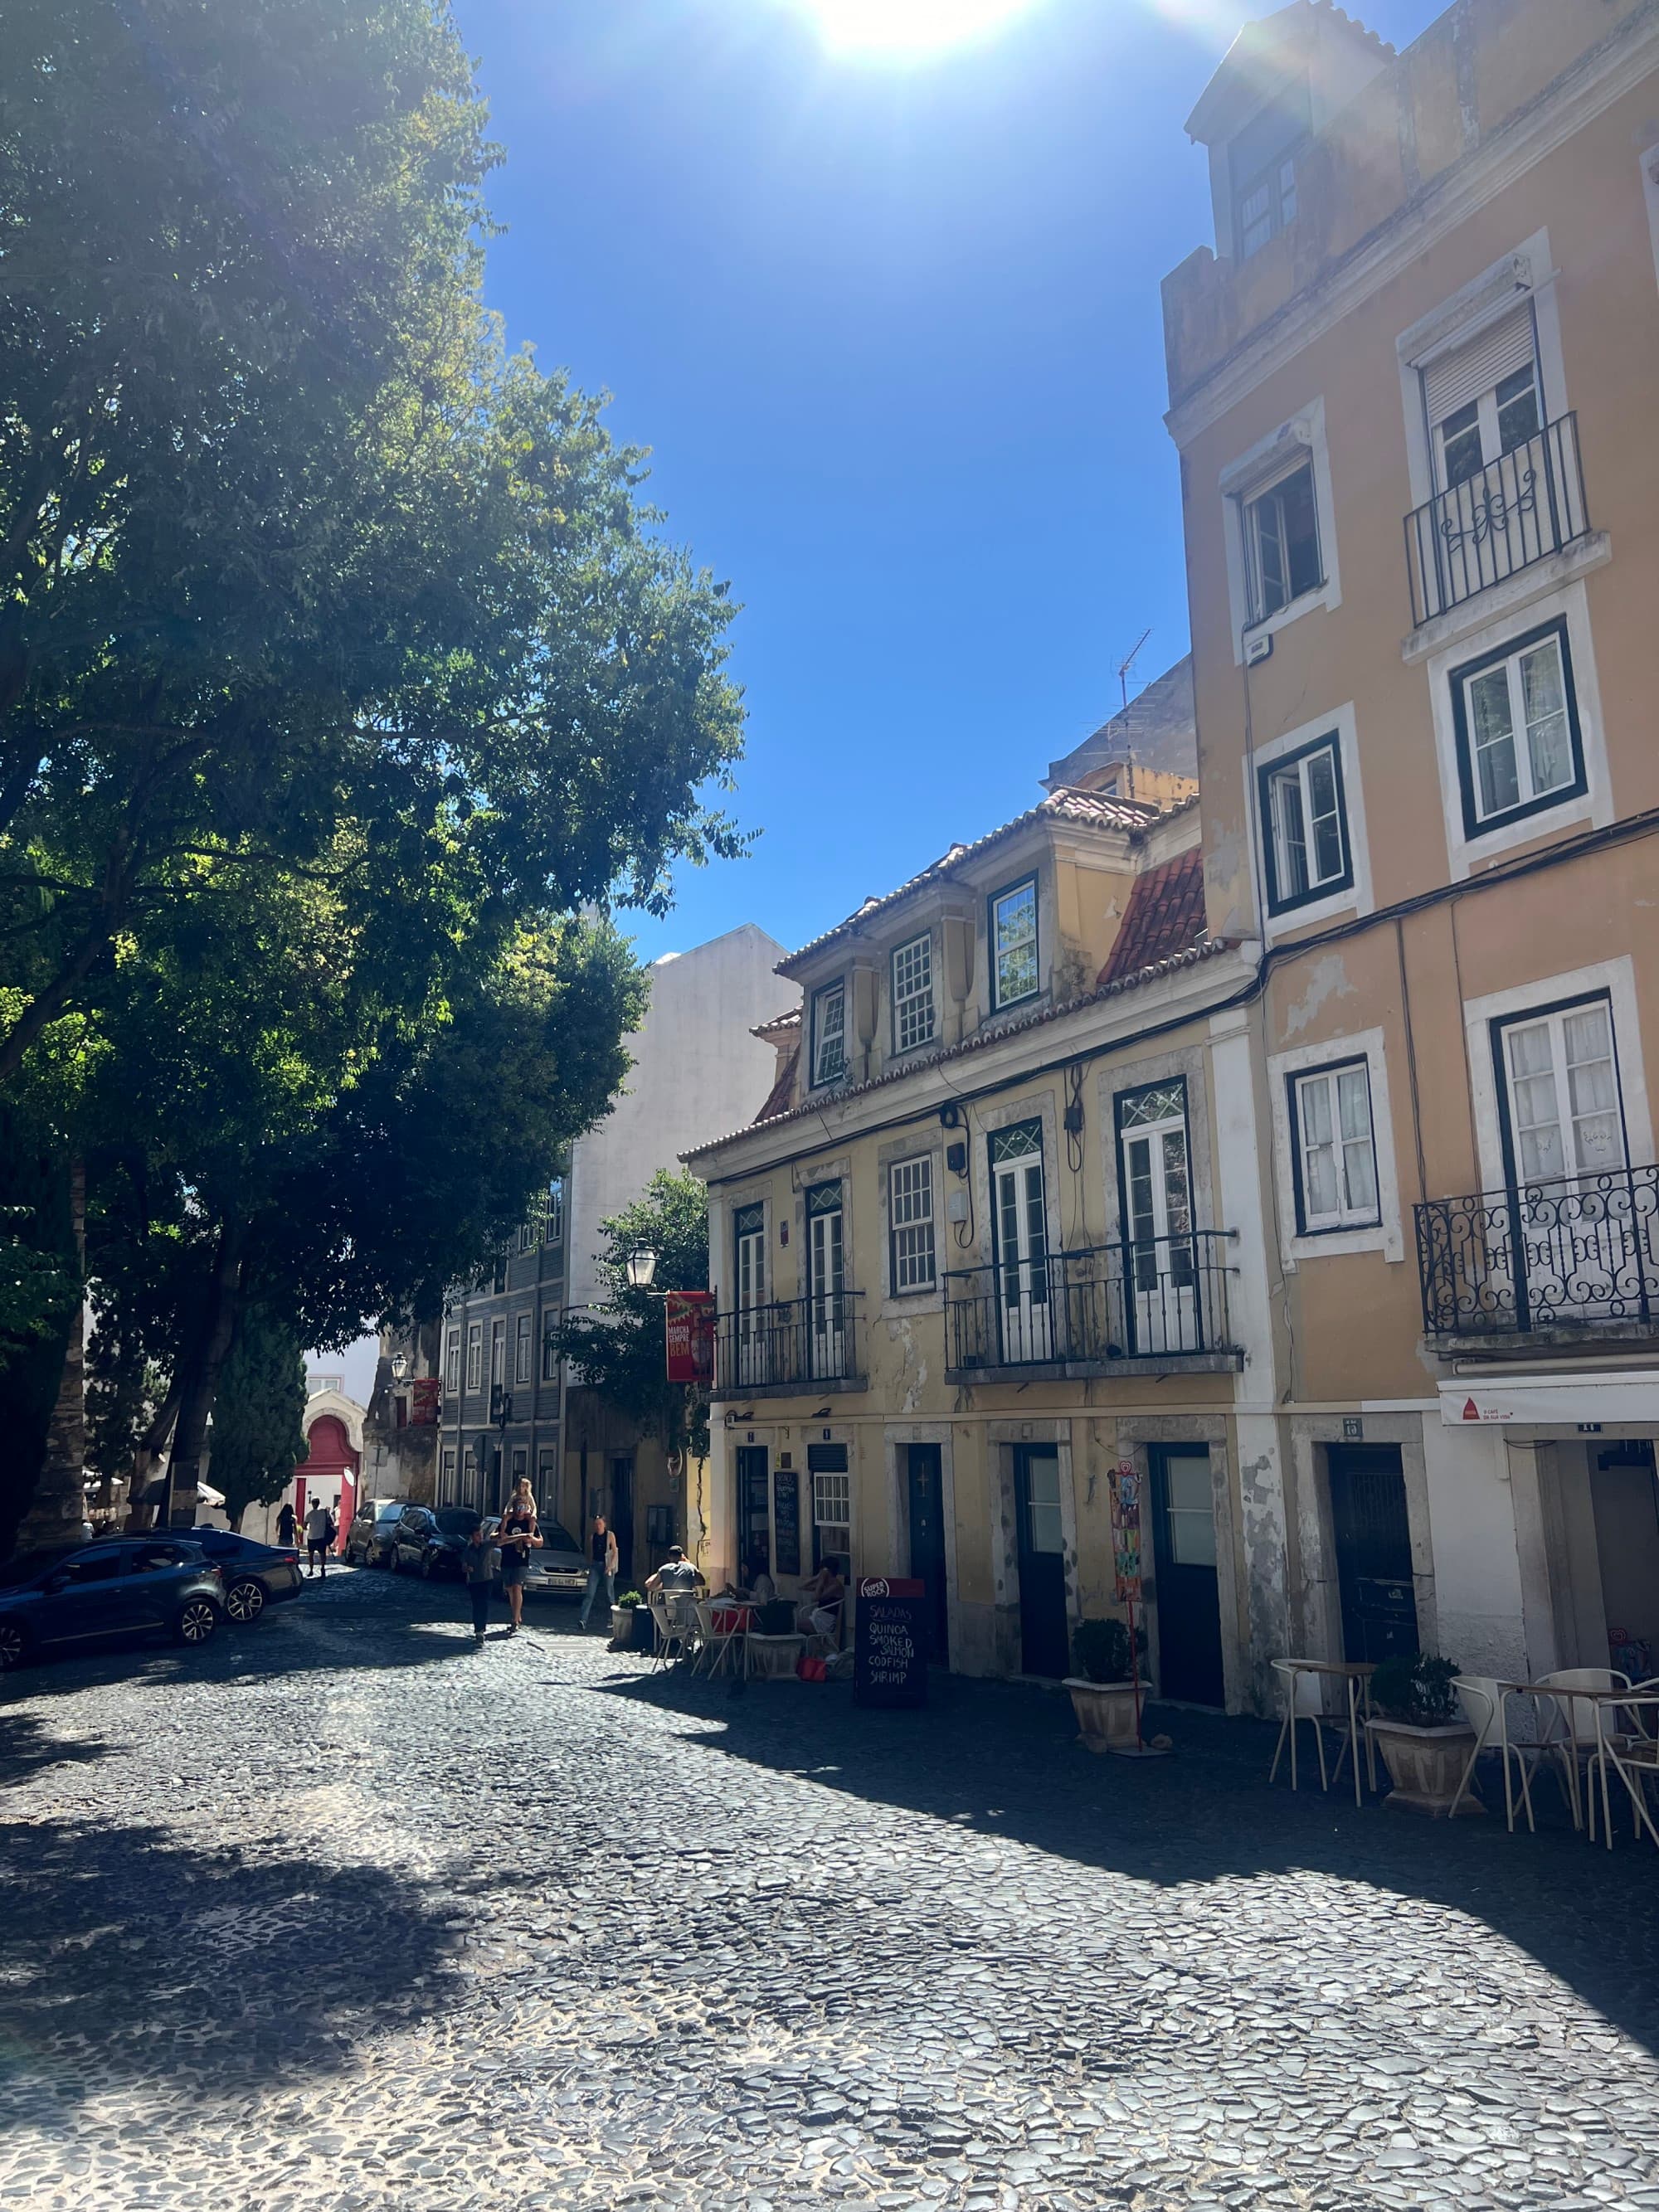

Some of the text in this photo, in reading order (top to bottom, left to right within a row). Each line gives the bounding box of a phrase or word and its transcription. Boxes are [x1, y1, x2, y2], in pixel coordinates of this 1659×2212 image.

[669, 1325, 690, 1334] MARCHA
[669, 1333, 690, 1343] SEMPRE
[669, 1341, 690, 1357] BEM
[864, 1581, 884, 1593] SUPER
[869, 1622, 908, 1635] QUINOA
[869, 1635, 912, 1648] SMOKED
[880, 1645, 914, 1659] SALMON
[868, 1655, 908, 1670] CODFISH
[869, 1670, 907, 1685] SHRIMP
